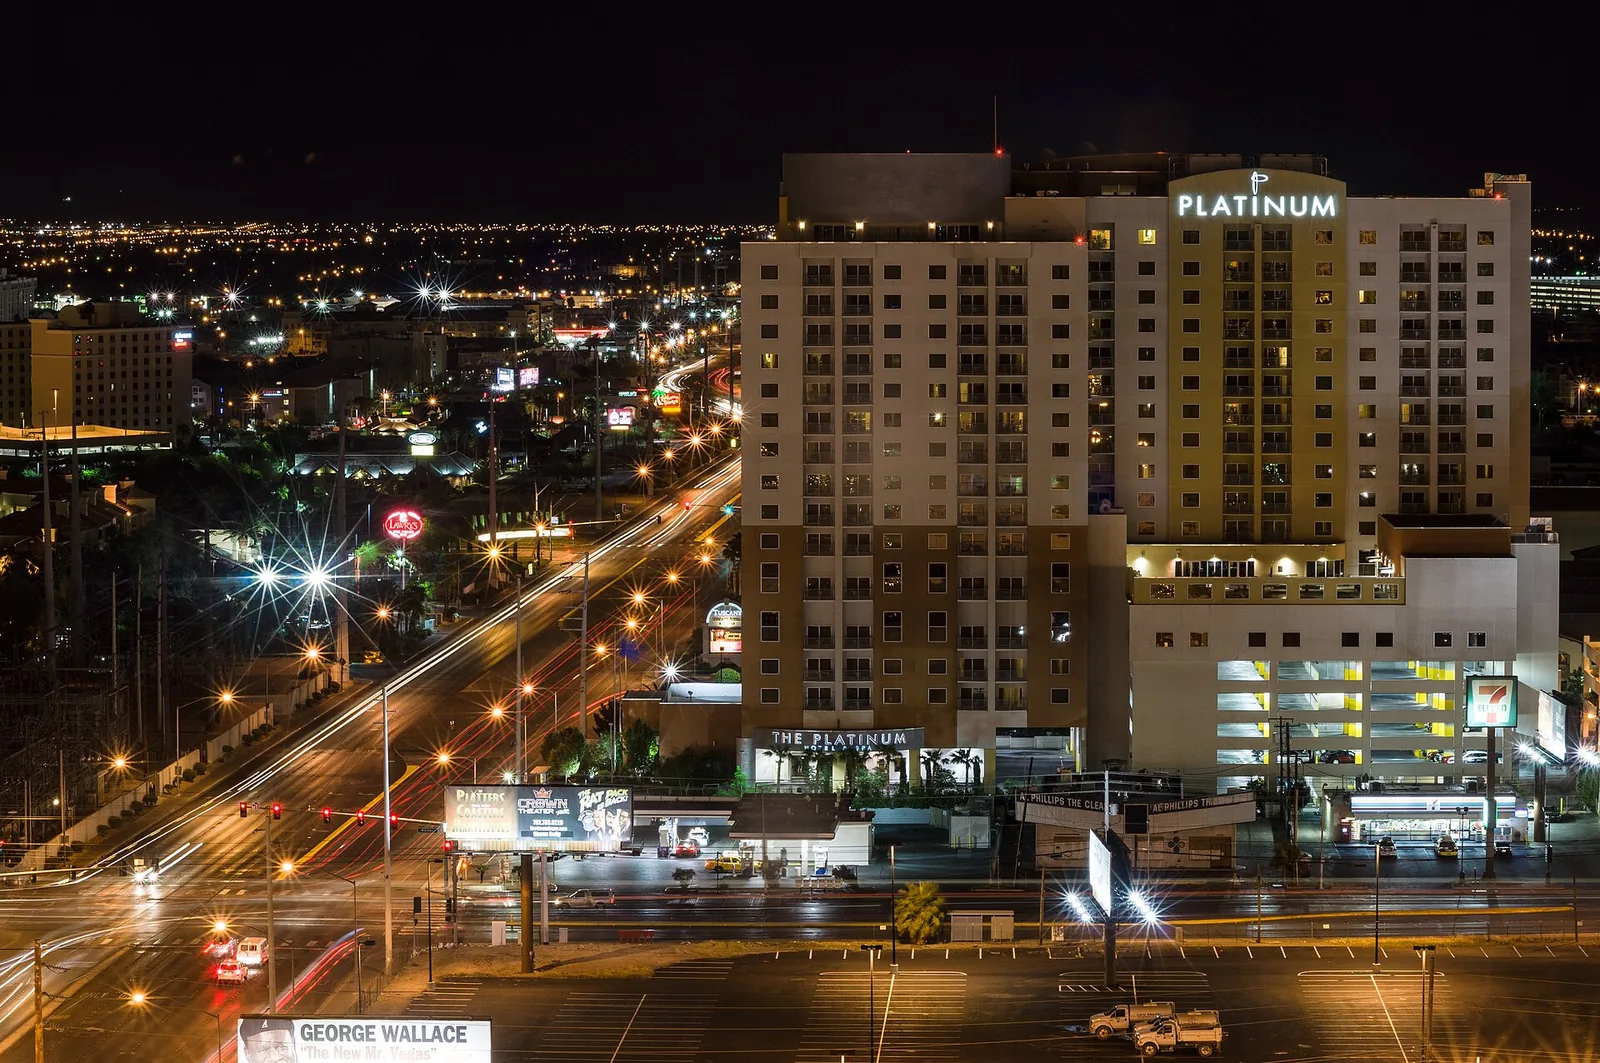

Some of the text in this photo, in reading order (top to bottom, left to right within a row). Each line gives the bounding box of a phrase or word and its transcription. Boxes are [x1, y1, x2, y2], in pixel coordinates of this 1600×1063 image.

[1178, 195, 1336, 217] PLATINUM
[772, 731, 907, 746] THE PLATINUM
[517, 798, 568, 808] CROWN
[579, 790, 605, 813] RAT
[1031, 793, 1065, 806] PHILLIPS
[1067, 797, 1082, 808] THE
[1084, 800, 1104, 810] CLEA
[1164, 799, 1199, 811] PHILLIPS
[300, 1023, 467, 1043] GEORGE WALLACE
[333, 1045, 363, 1060] New
[366, 1046, 386, 1061] Mr.
